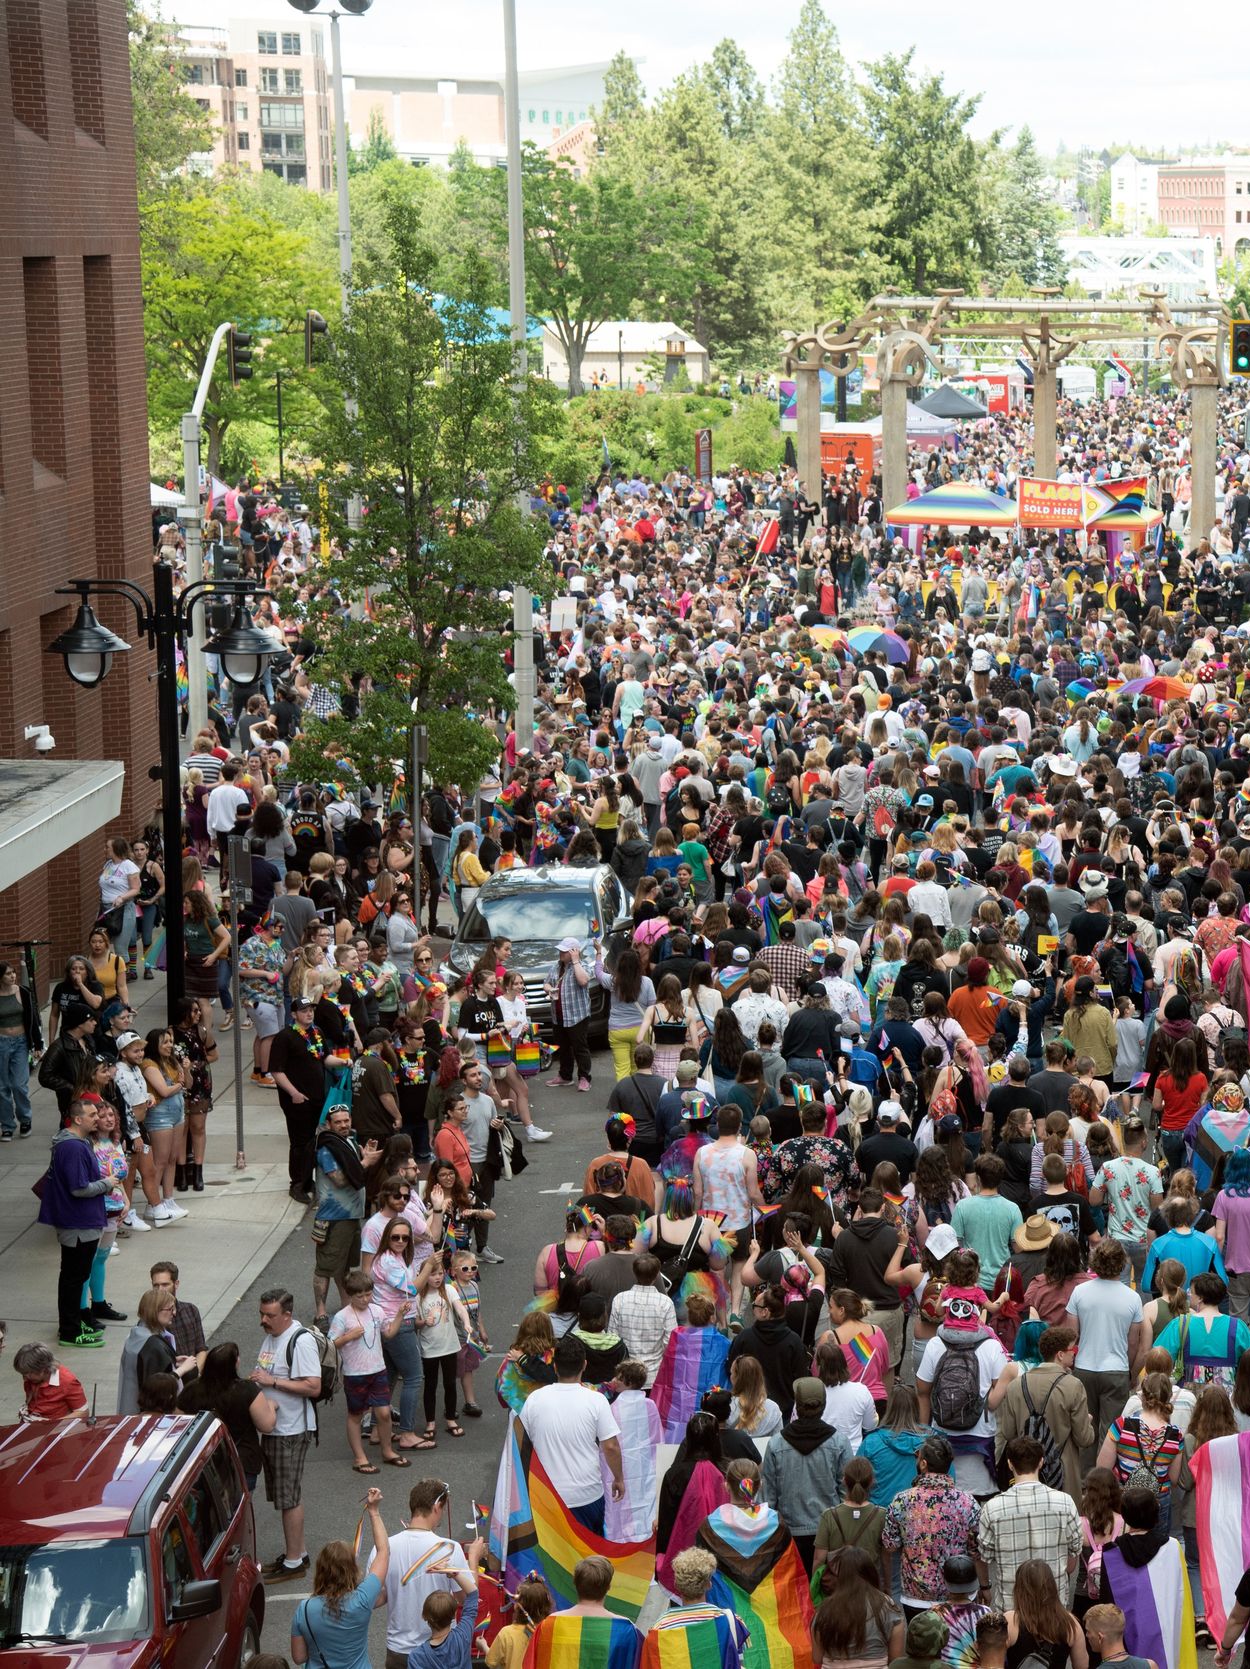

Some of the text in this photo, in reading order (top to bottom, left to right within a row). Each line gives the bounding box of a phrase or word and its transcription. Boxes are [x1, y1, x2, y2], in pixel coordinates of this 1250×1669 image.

[1023, 481, 1082, 501] FLAGS
[1023, 504, 1079, 516] SOLD HERE
[291, 817, 313, 827] PROUD
